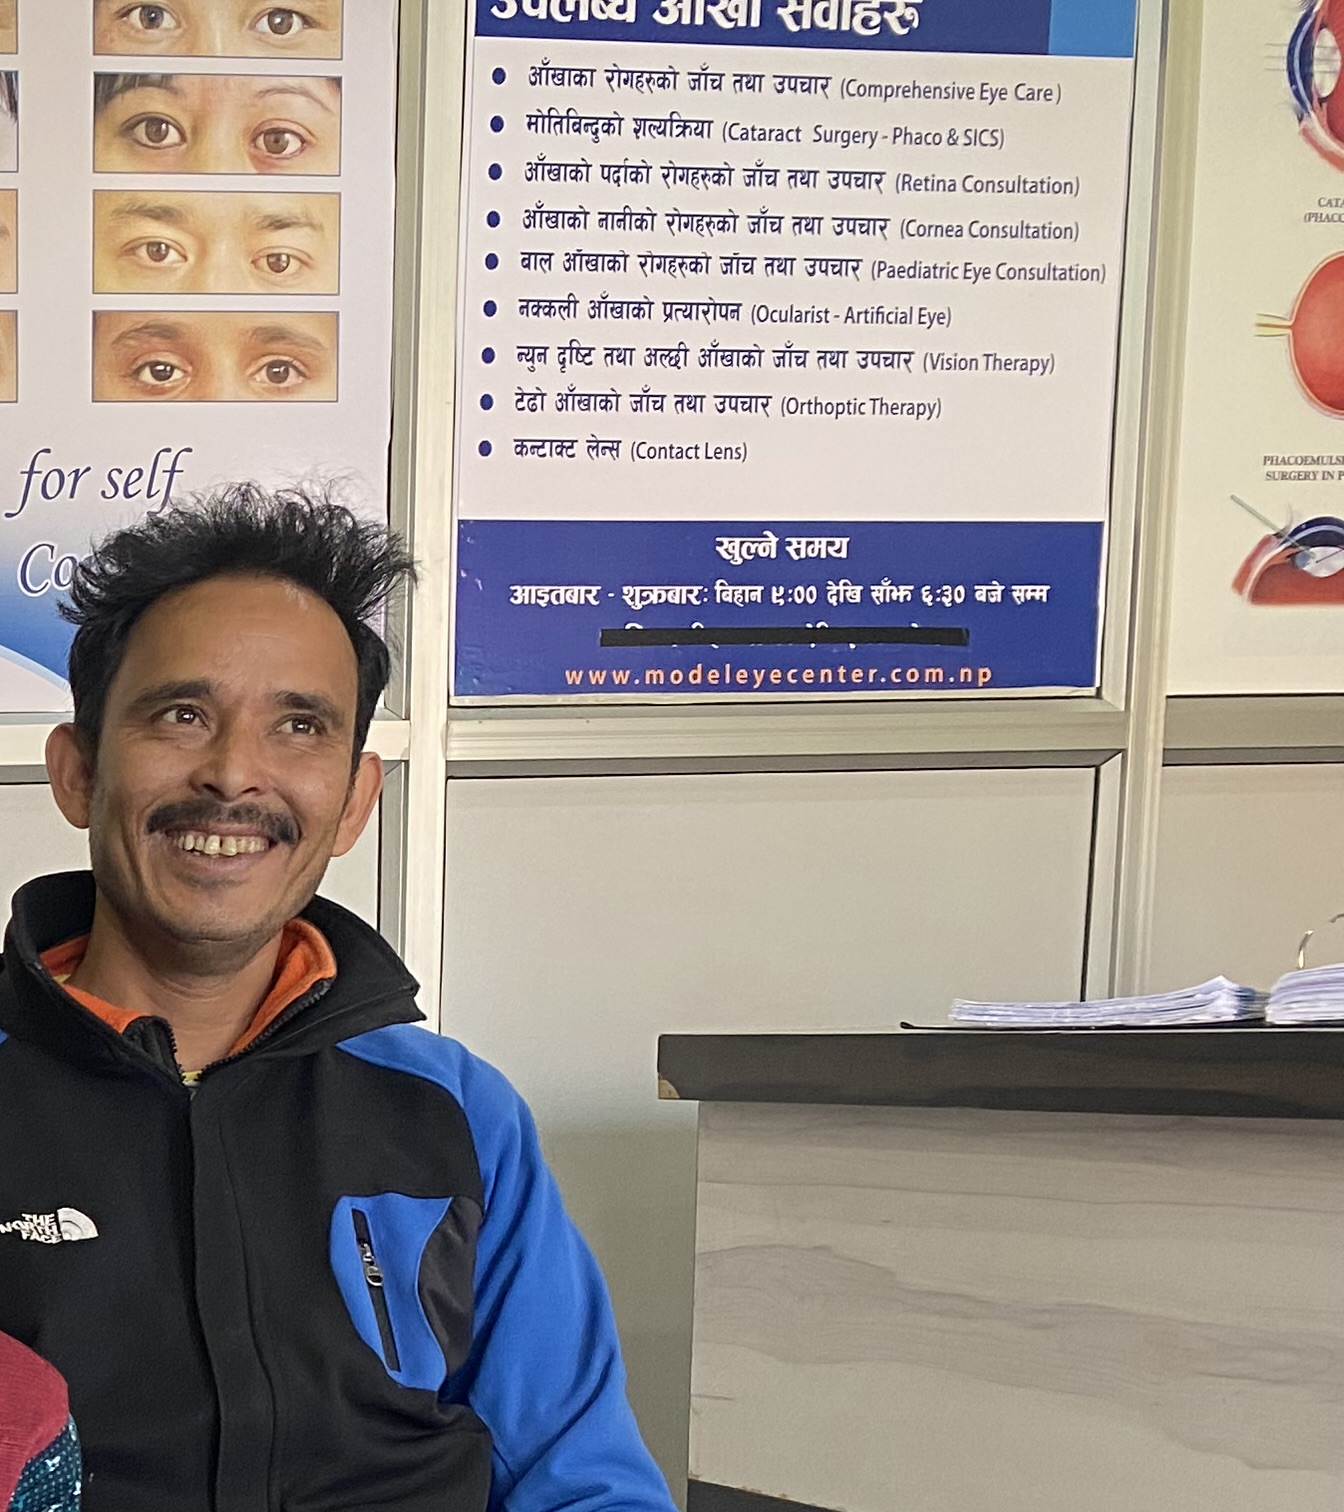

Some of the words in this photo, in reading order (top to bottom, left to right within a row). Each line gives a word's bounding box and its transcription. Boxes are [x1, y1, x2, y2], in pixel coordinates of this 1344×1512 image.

[632, 112, 714, 140] शल्यक्रिया
[722, 121, 801, 144] (Cataract
[813, 125, 878, 149] Surgery
[892, 127, 942, 146] Phaco
[947, 129, 959, 146] &
[964, 128, 1005, 150] SICS)
[518, 292, 579, 319] नक्कली
[588, 290, 654, 320] आँखाको
[663, 296, 742, 325] प्रत्यारोपन
[751, 304, 830, 326] (Ocularist
[844, 306, 913, 325] Artificial
[917, 307, 952, 328] Eye)
[514, 439, 577, 459] कन्टाक्ट
[586, 434, 621, 459] लेन्स
[630, 441, 701, 462] (Contact
[704, 441, 747, 463] Lens)
[4, 447, 92, 519] for
[100, 447, 193, 518] self
[715, 531, 779, 563] खुल्ने
[785, 535, 848, 560] समय
[510, 585, 601, 607] आइतबार
[826, 579, 864, 607] देखि
[1012, 585, 1050, 606] सम्म
[564, 664, 993, 687] www.modeleyecenter.com.np
[21, 1213, 55, 1225] THE
